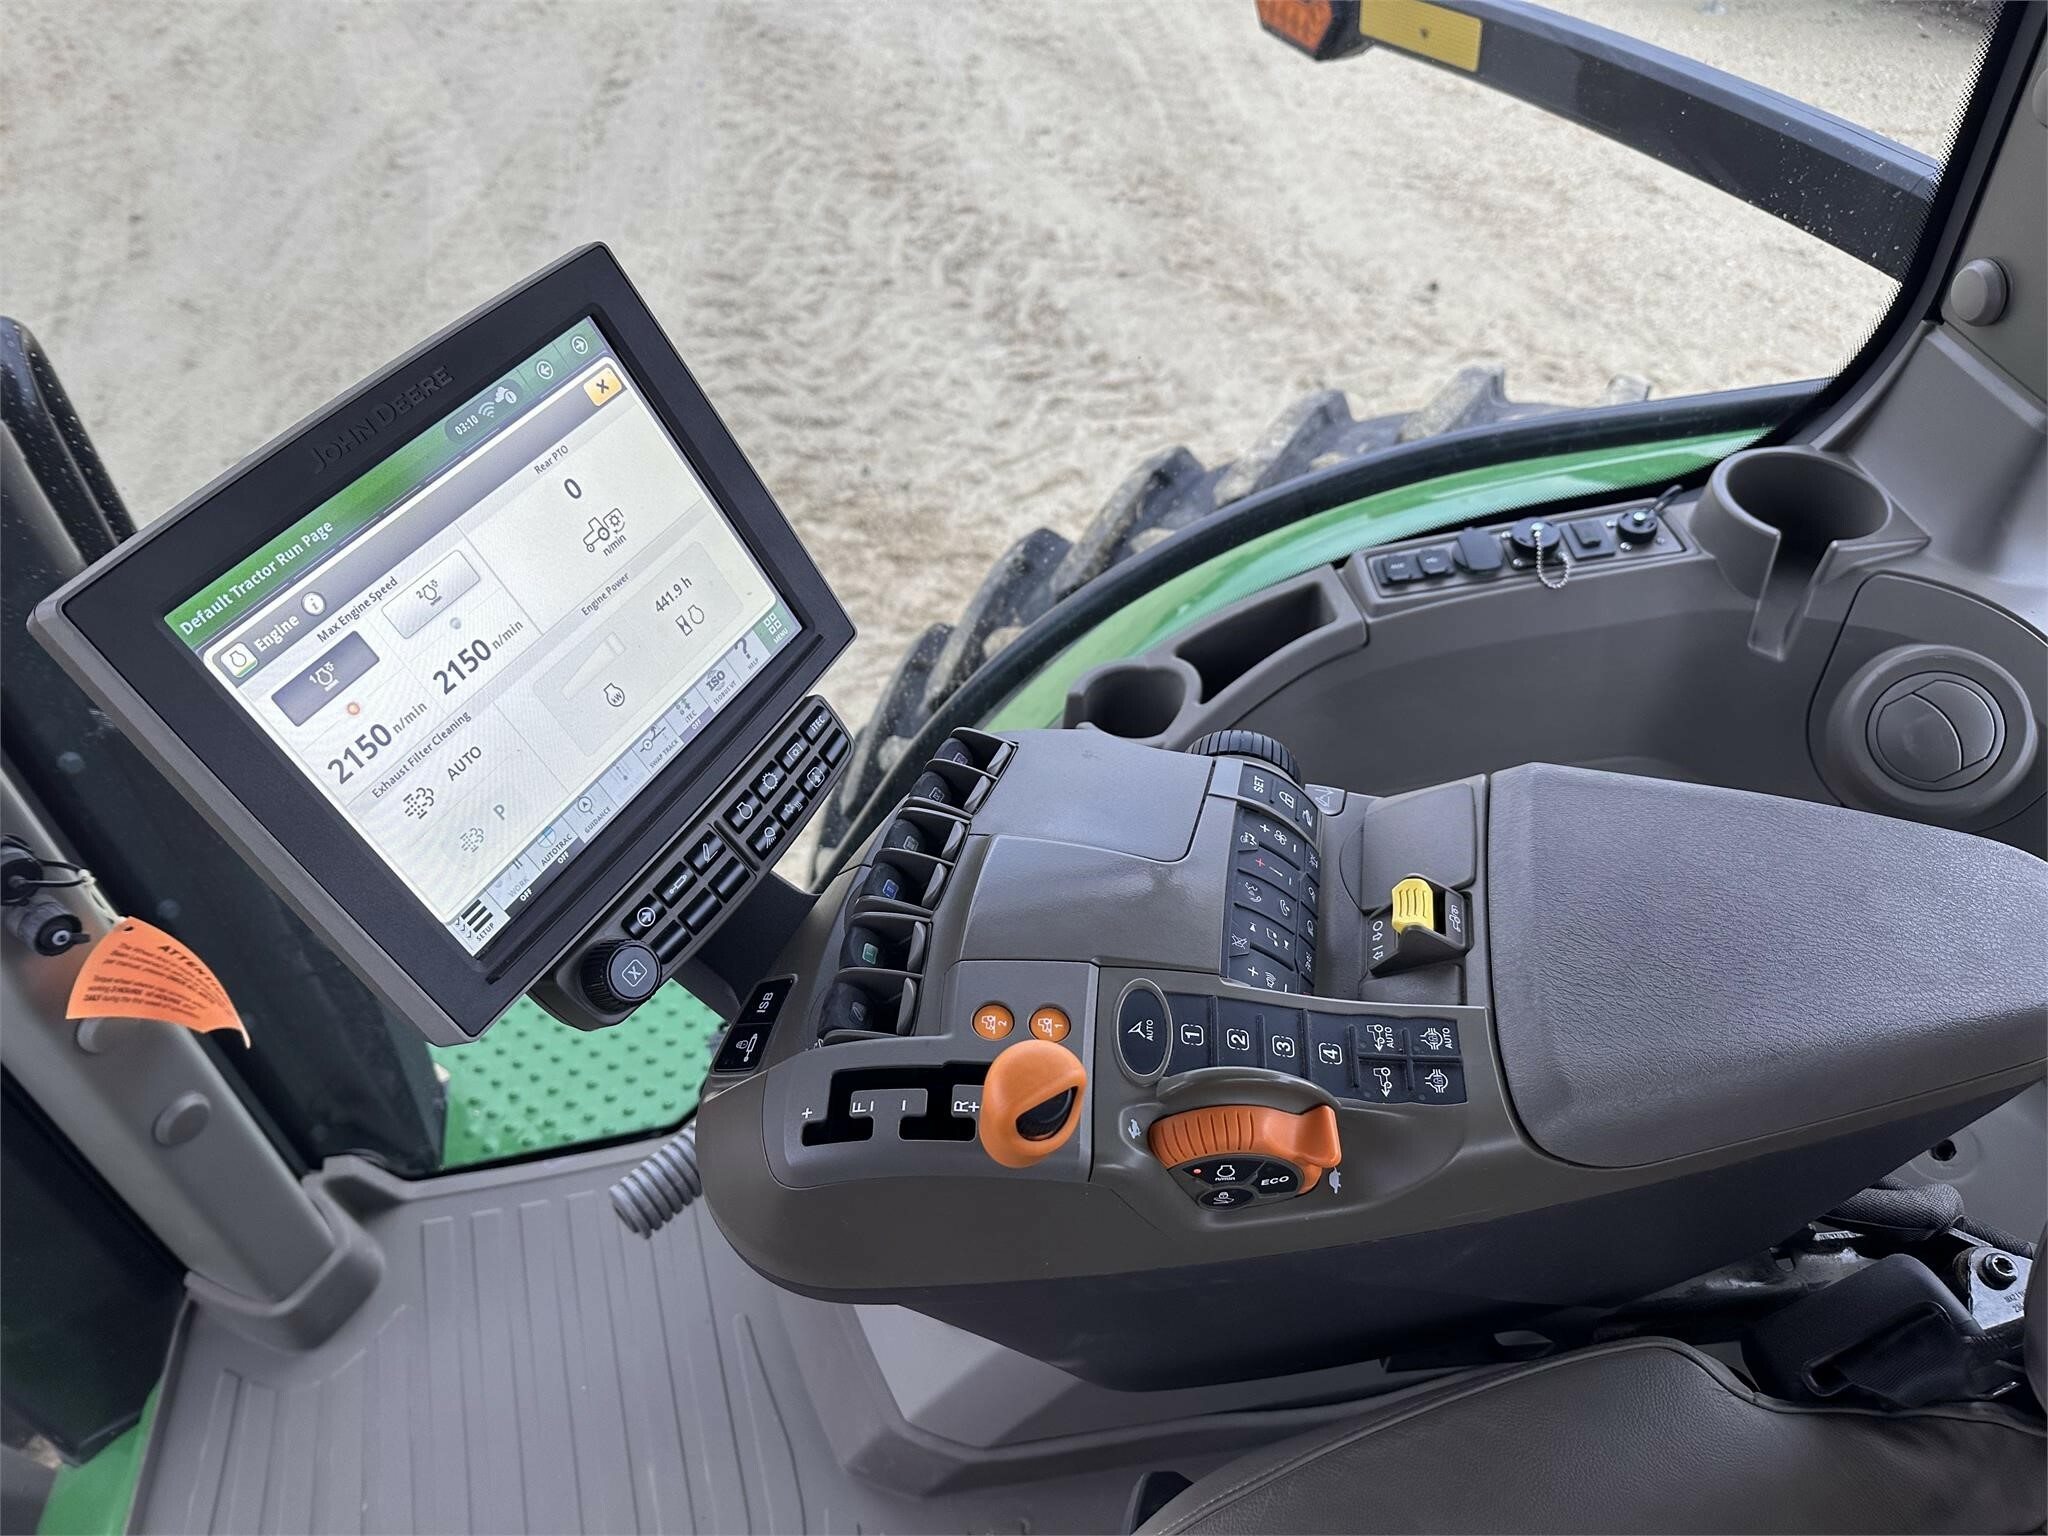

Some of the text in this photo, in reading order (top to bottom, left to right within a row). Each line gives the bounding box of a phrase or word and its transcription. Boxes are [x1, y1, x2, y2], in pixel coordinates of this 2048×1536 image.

[313, 365, 456, 474] JOHN DEERE
[454, 414, 479, 436] 03:10
[534, 444, 569, 475] Rear PTO
[563, 478, 582, 499] 0
[602, 533, 627, 557] n/min
[179, 521, 334, 636] Default Tractor Run Page
[580, 572, 630, 616] Engine Power
[655, 577, 693, 612] 441.9 h
[316, 575, 398, 643] Max Engine Speed
[253, 615, 300, 652] Engine
[773, 626, 789, 644] MENU
[432, 620, 524, 695] 2150 n/min
[705, 670, 726, 692] ISO
[809, 715, 825, 732] iTEC
[327, 701, 428, 785] 2150 n/min
[649, 738, 679, 769] SWAP TRACK
[371, 711, 472, 799] Exhaust Filter Cleaning
[447, 746, 482, 781] AUTO
[1253, 775, 1265, 793] SET
[492, 804, 505, 821] P
[584, 805, 612, 834] GUIDANCE
[540, 833, 573, 867] AUTOTRAC
[557, 851, 569, 864] OFF
[507, 876, 530, 898] WORK
[520, 887, 533, 901] OFF
[476, 922, 494, 942] SETUP
[756, 992, 773, 1013] ISB
[997, 1019, 1008, 1027] 2
[1146, 1019, 1154, 1042] AUTO
[1184, 1030, 1200, 1039] 1
[1230, 1032, 1246, 1045] 2
[1384, 1026, 1394, 1049] AUTO
[1442, 1027, 1453, 1049] AUTO
[1275, 1040, 1291, 1052] 3
[1322, 1048, 1338, 1060] 4
[851, 1101, 866, 1114] F
[953, 1100, 969, 1113] R
[1260, 1175, 1289, 1186] ECO
